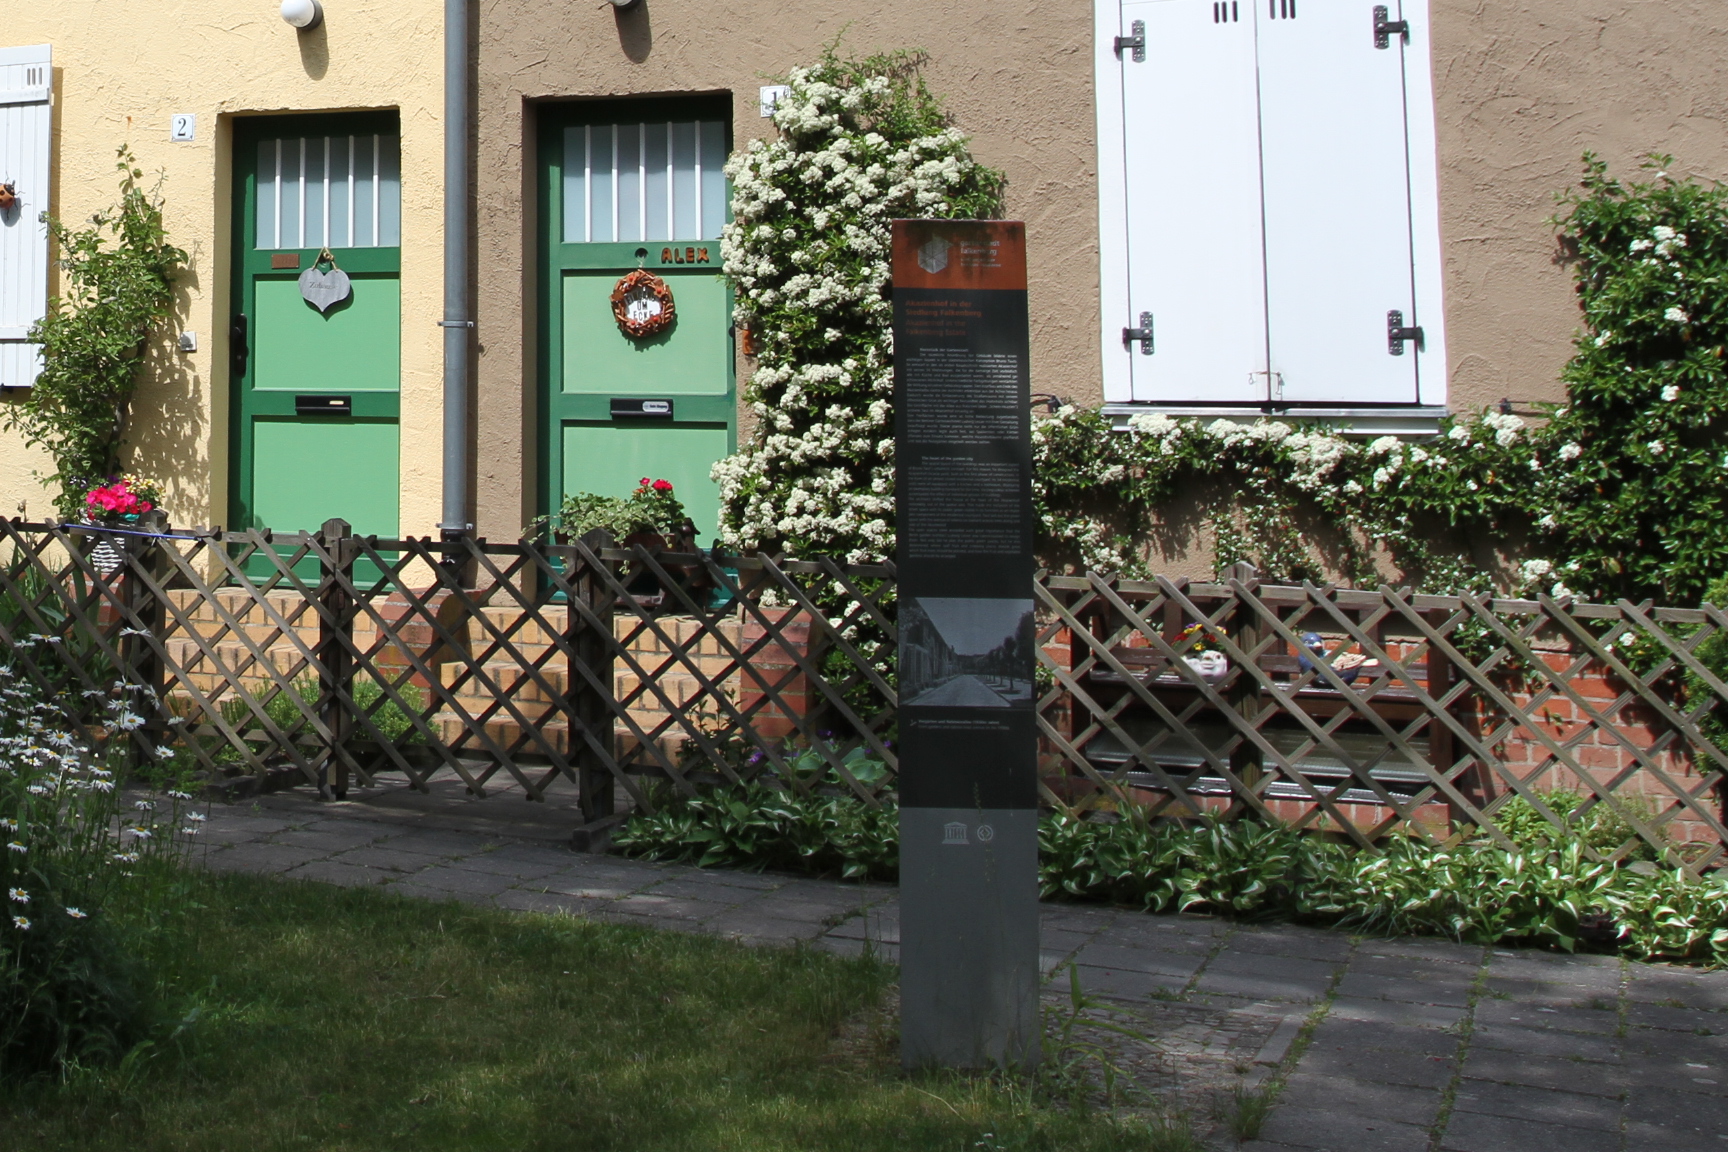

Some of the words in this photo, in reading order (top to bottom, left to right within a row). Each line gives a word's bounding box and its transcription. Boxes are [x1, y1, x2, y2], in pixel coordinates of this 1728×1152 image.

[177, 118, 186, 136] 2
[661, 247, 709, 264] ALEX
[960, 247, 997, 256] falkenbrg
